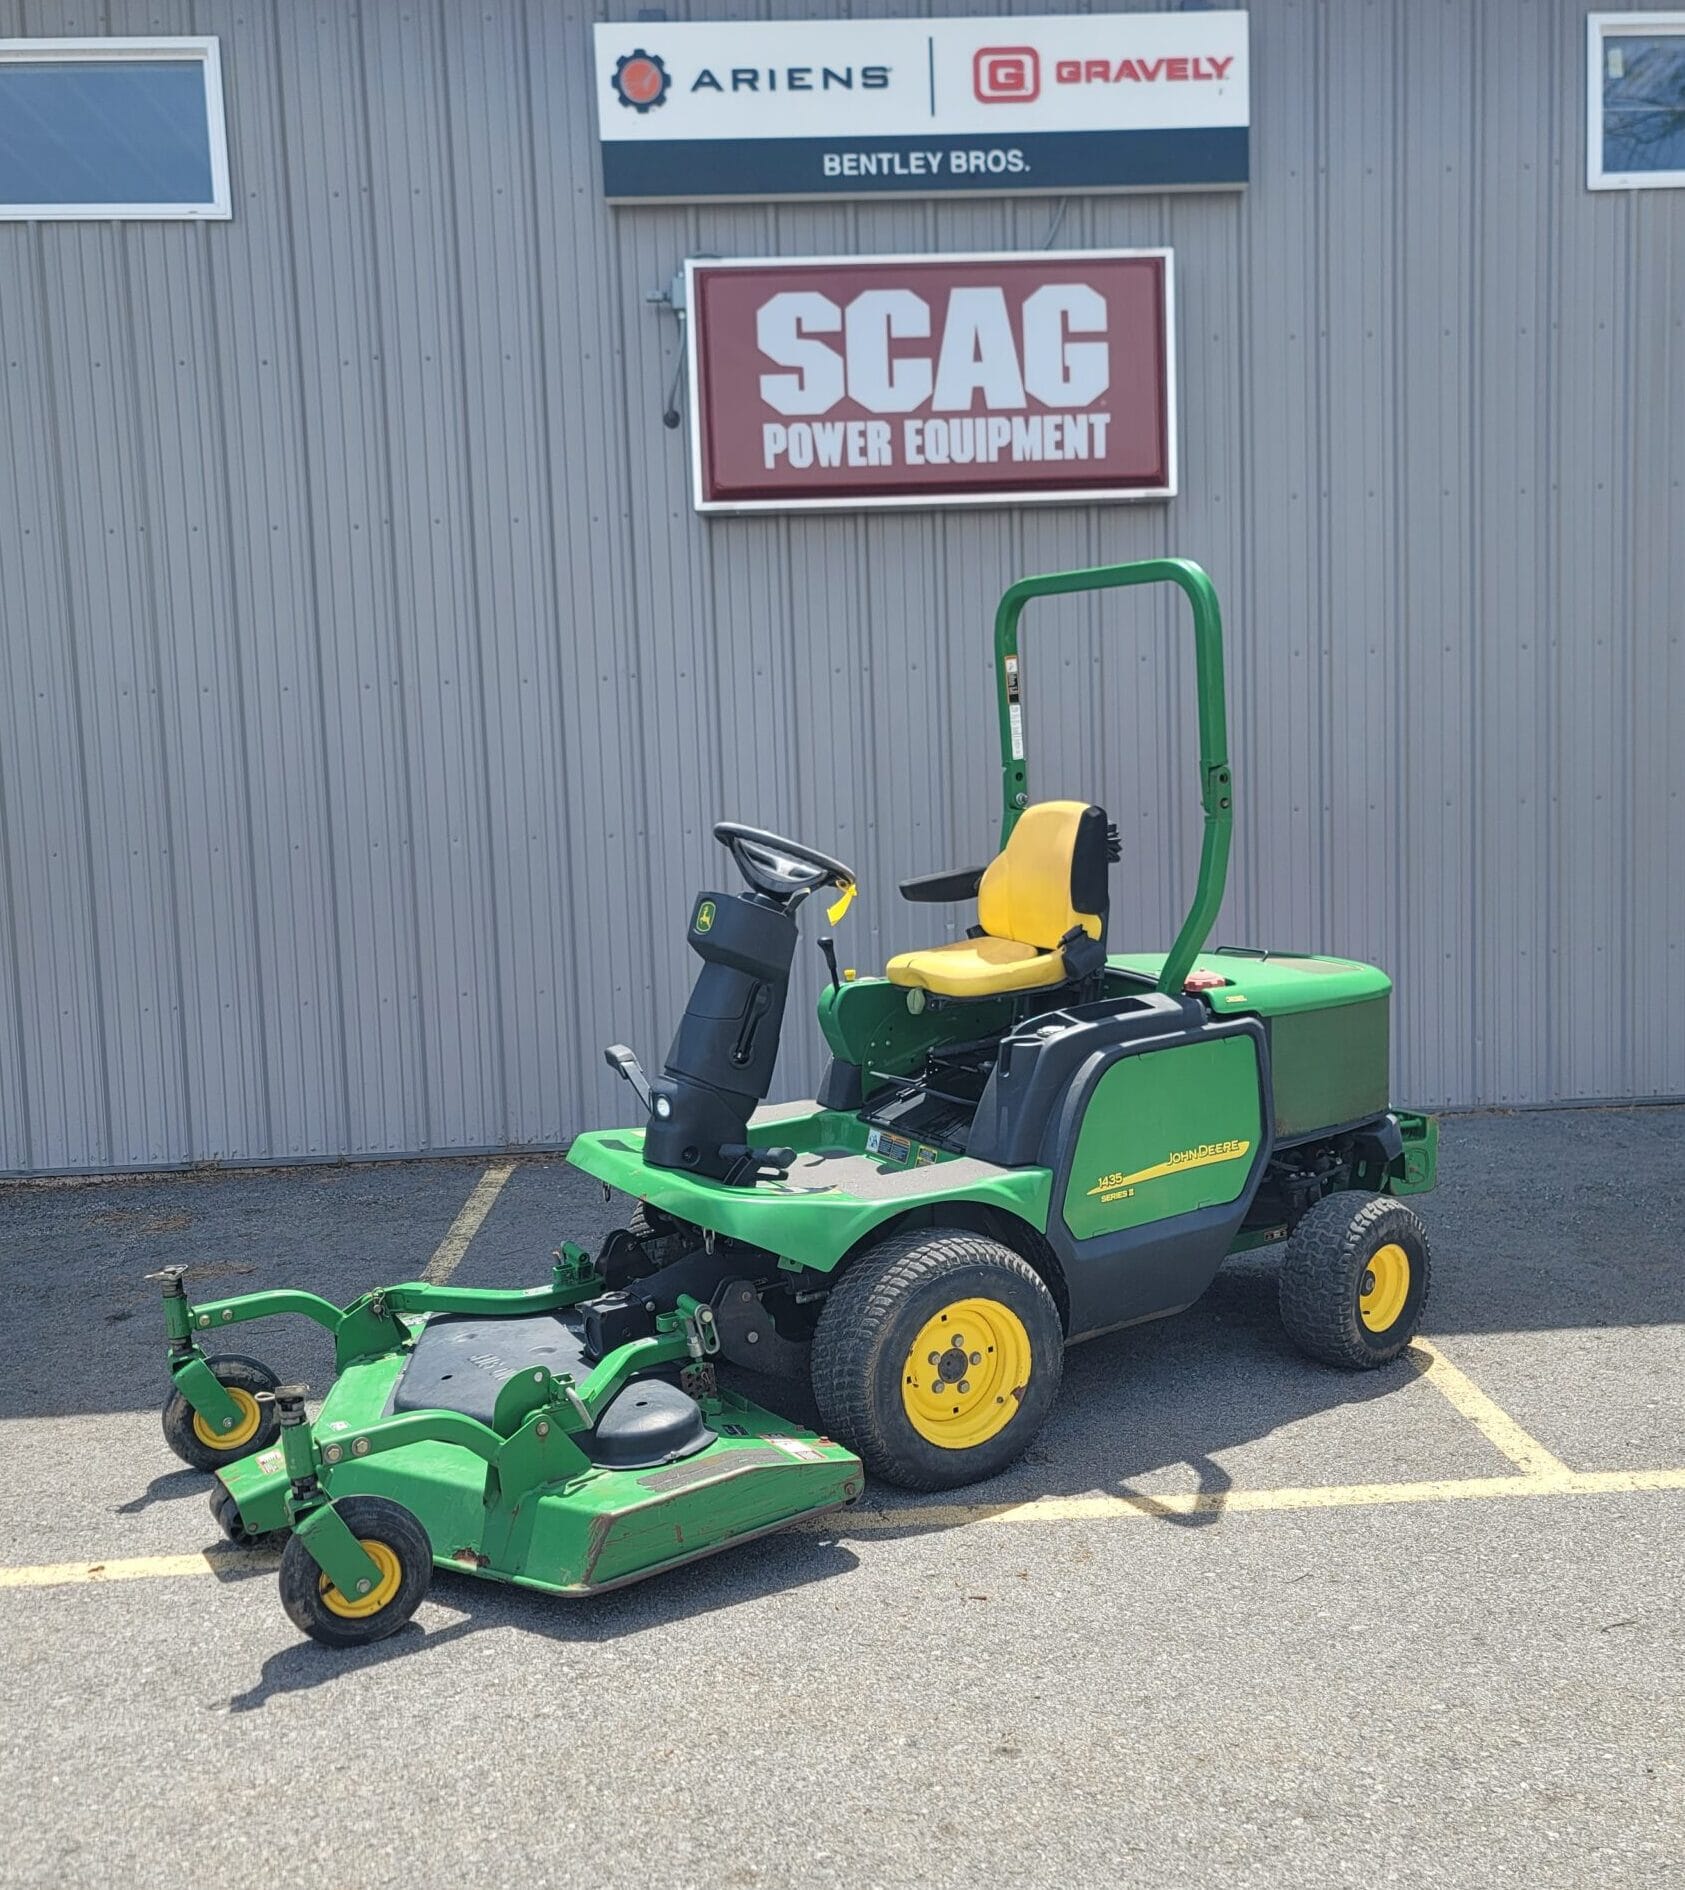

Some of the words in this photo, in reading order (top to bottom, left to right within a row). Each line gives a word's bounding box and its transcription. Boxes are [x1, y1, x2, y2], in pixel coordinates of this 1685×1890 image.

[690, 66, 889, 93] ARIENS
[1056, 56, 1234, 84] GRAVELY
[823, 152, 943, 177] BENTLEY
[950, 149, 1031, 173] BROS.
[756, 283, 1110, 416] SCAG
[762, 420, 892, 470] POWER
[904, 413, 1111, 466] EQUIPMENT
[1168, 1148, 1197, 1165] JOHN
[1198, 1140, 1239, 1157] DEERE
[1098, 1173, 1123, 1188] 1435
[1101, 1190, 1126, 1202] SERIES
